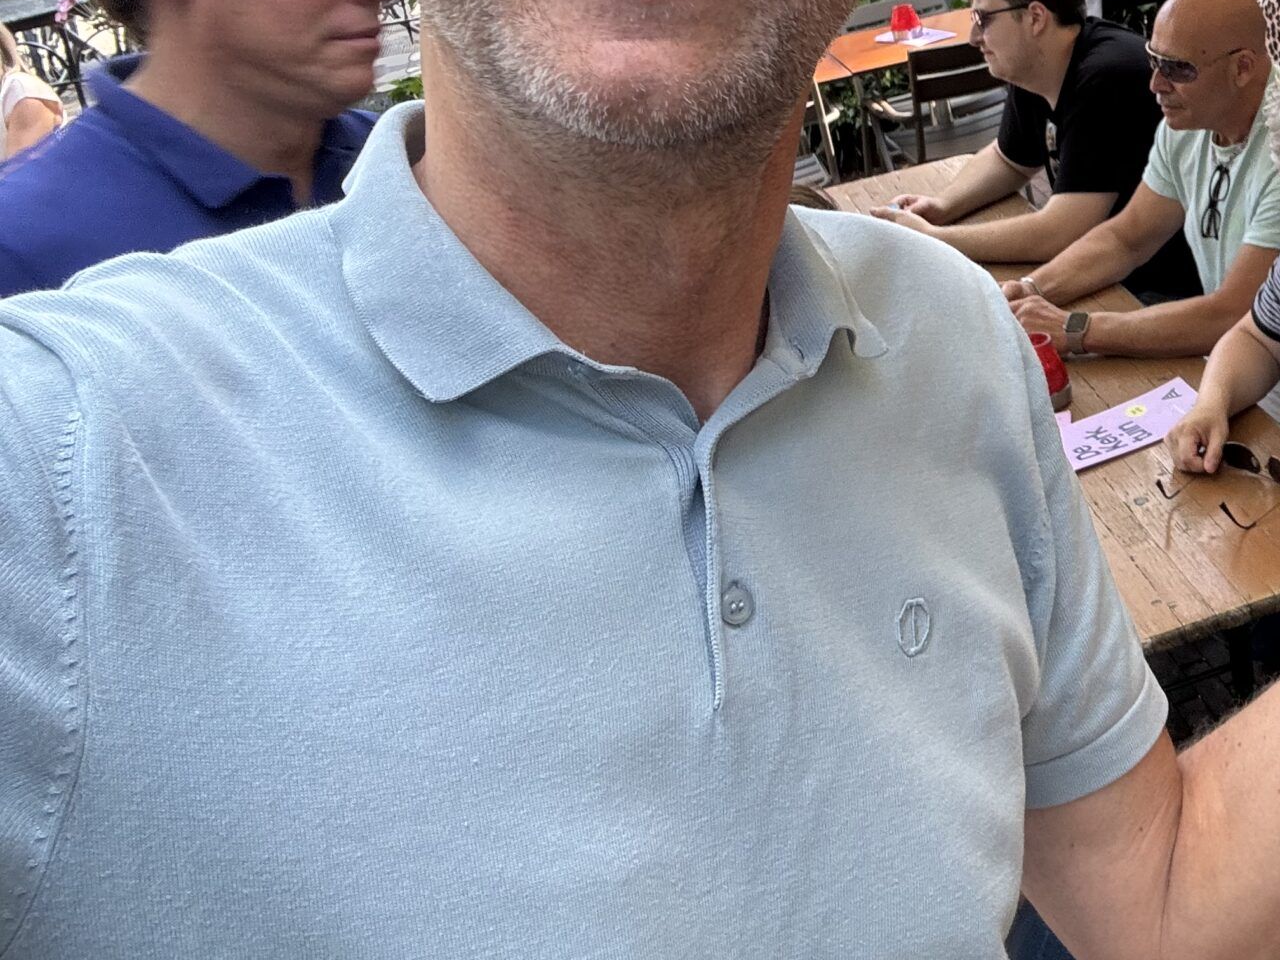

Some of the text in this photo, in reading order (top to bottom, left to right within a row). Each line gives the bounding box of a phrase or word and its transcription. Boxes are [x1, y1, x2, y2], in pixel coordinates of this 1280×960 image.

[1085, 426, 1129, 452] Kerk
[1118, 421, 1153, 443] tuin
[1073, 445, 1102, 461] De
